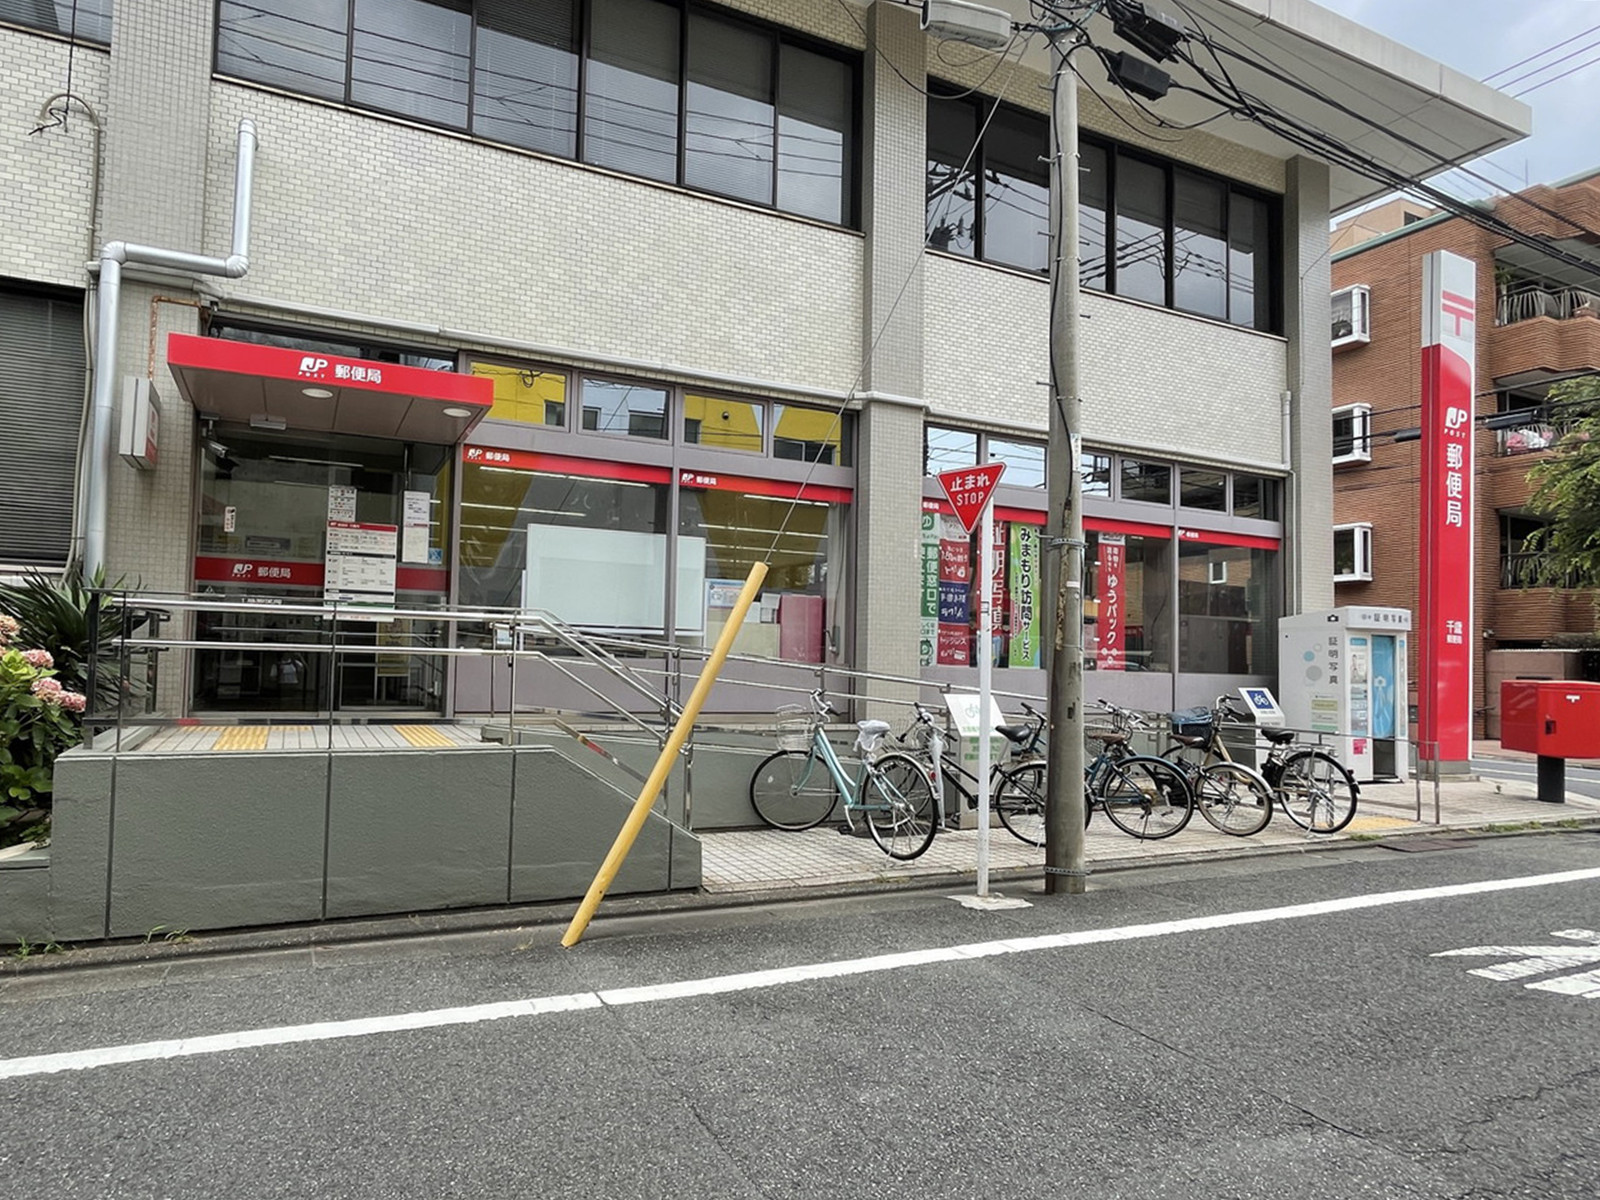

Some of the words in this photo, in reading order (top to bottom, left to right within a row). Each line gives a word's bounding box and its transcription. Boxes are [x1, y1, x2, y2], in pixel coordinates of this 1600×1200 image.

[334, 364, 382, 384] 郵便局
[1445, 407, 1468, 429] JP
[950, 472, 990, 492] 止まれ
[957, 491, 984, 507] STOP
[1446, 443, 1463, 528] 郵便局
[258, 566, 291, 578] 郵便局
[926, 546, 938, 615] 郵便窓口で
[1020, 527, 1032, 660] みまもり訪問サービス
[1106, 574, 1119, 645] ゆうパック
[1328, 637, 1339, 684] 証明写真
